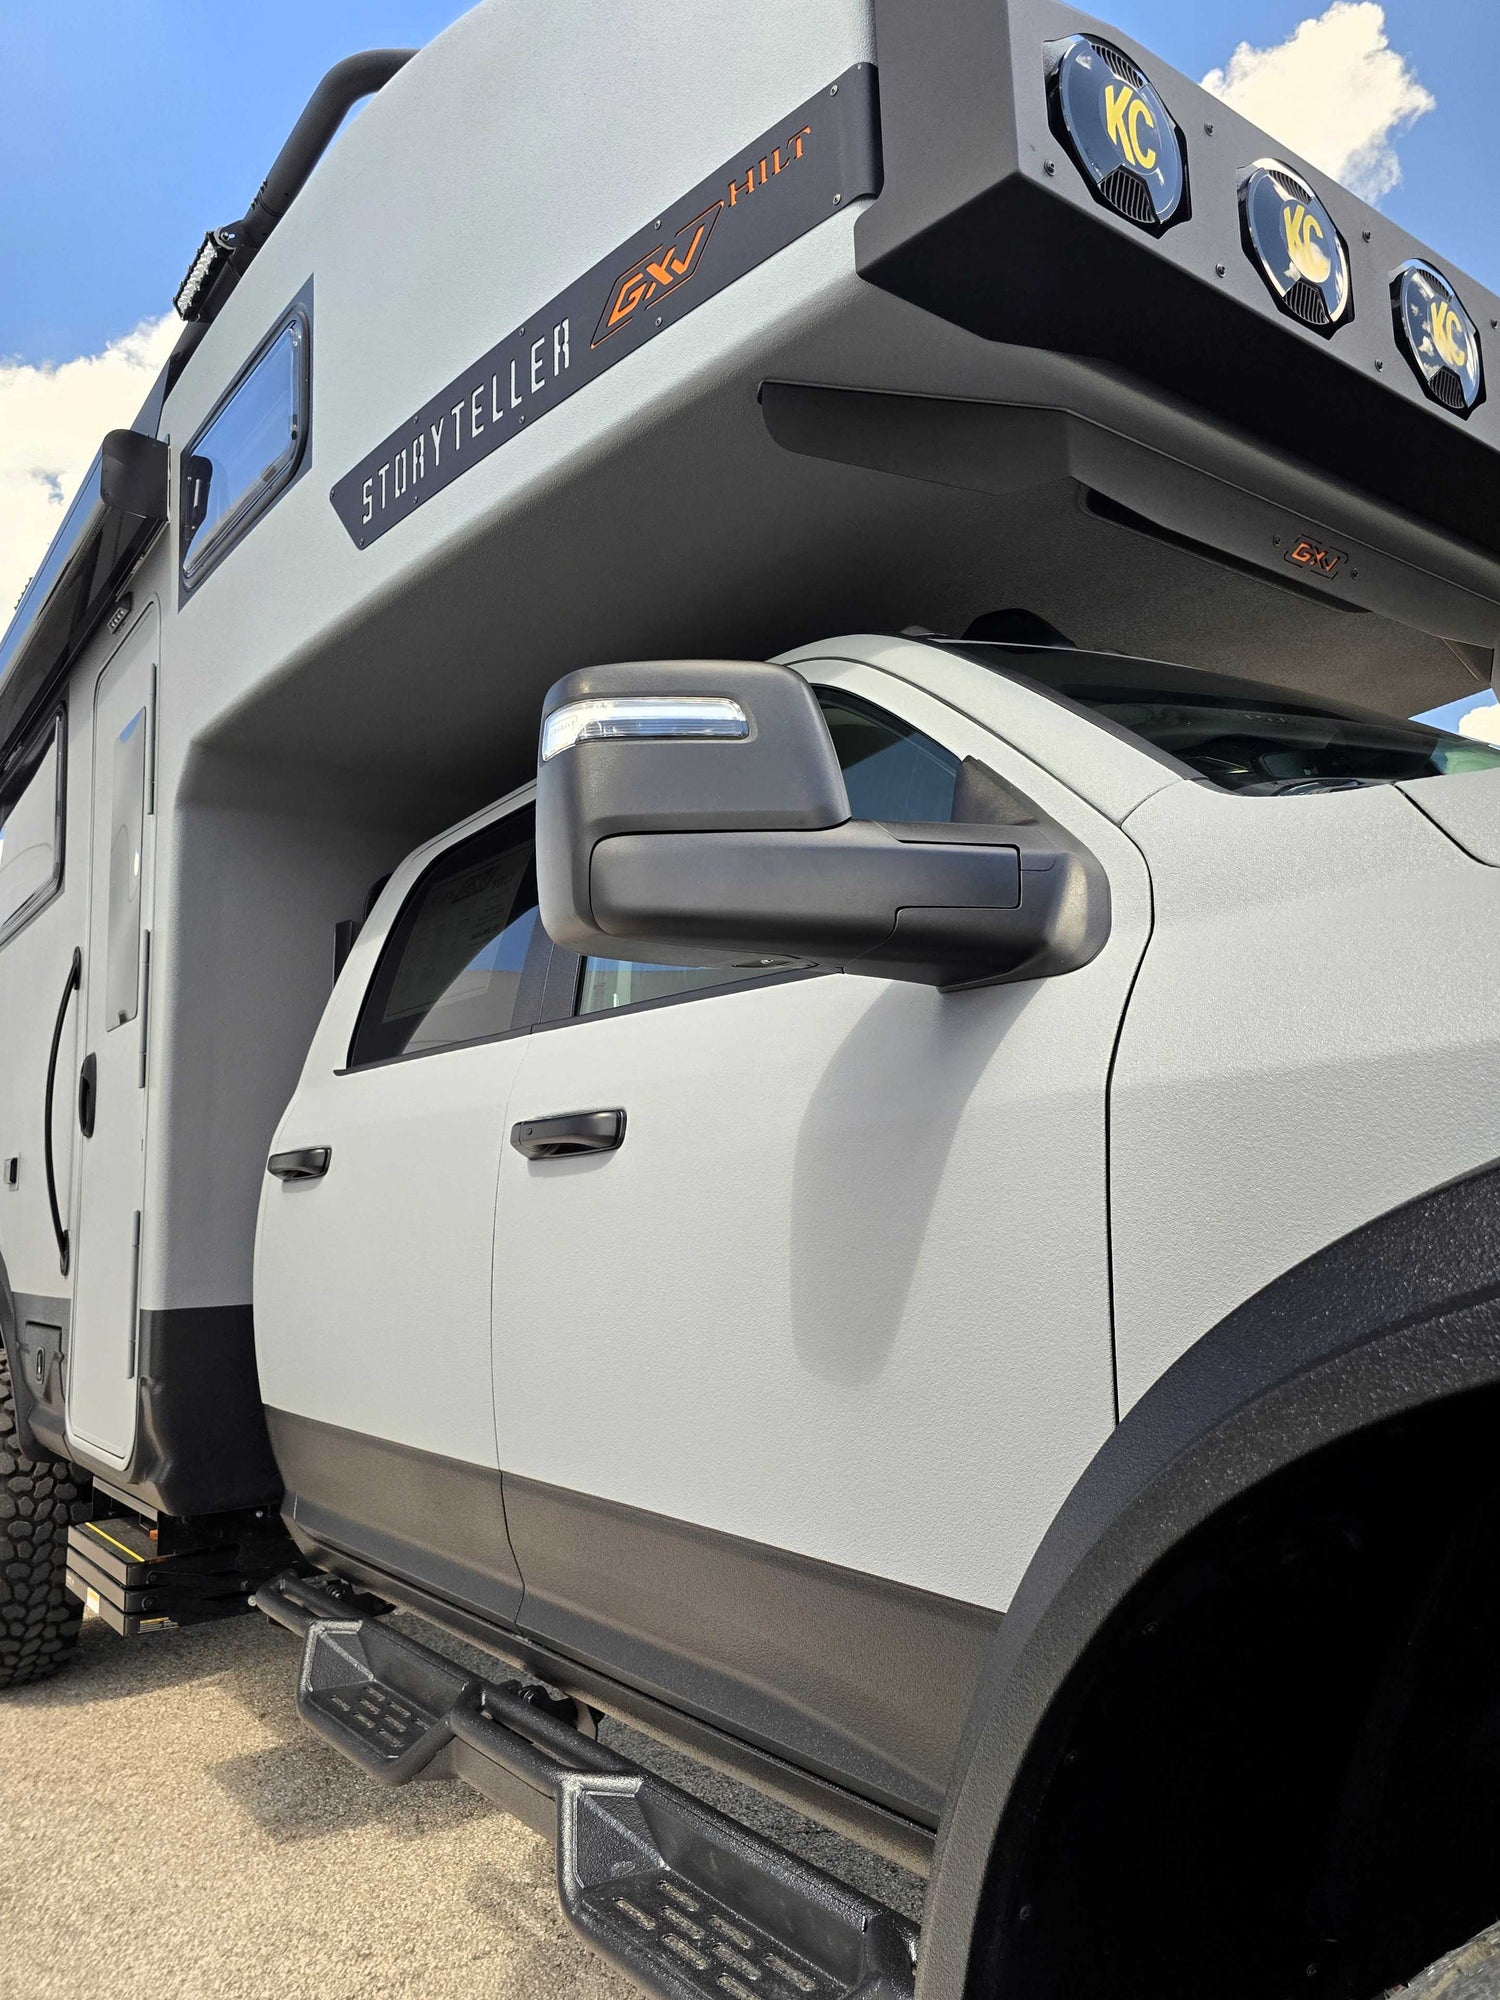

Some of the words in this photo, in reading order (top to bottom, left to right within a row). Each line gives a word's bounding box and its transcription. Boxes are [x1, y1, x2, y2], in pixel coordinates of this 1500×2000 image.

[1105, 84, 1156, 170] KC
[1284, 204, 1329, 283] KC
[362, 317, 570, 525] STORYTELLER
[729, 126, 811, 207] HILT
[1430, 300, 1466, 367] KC
